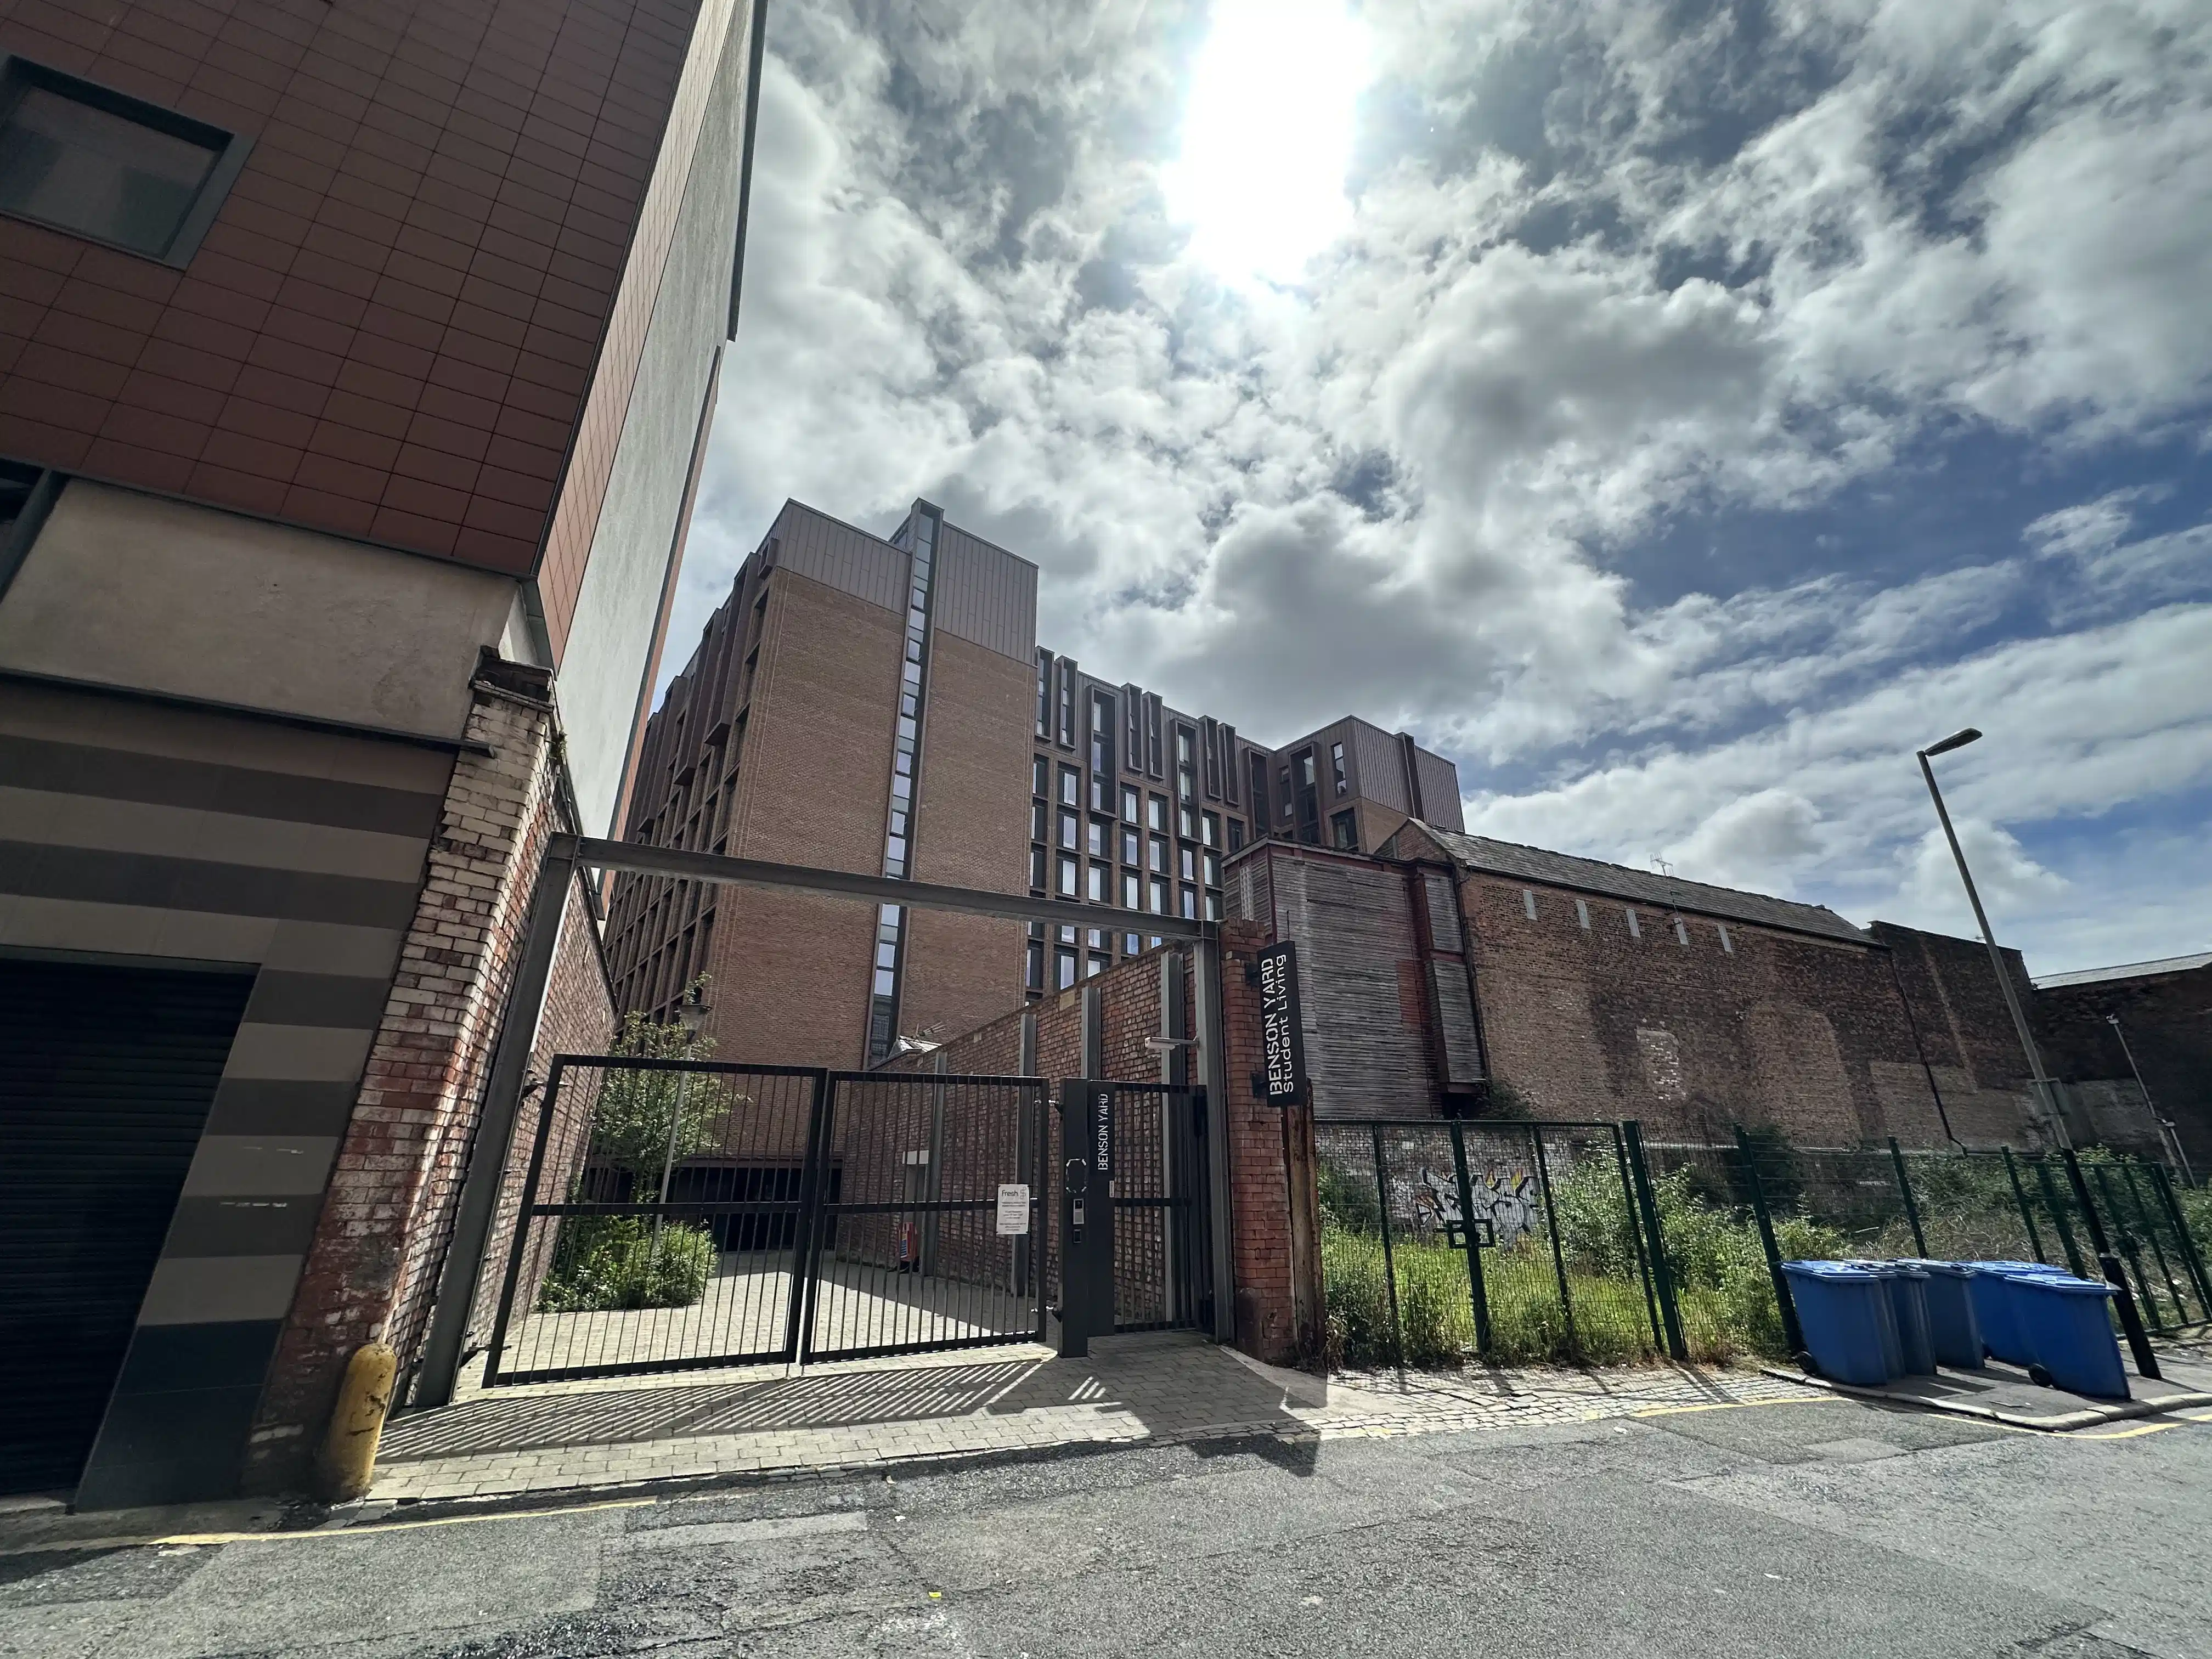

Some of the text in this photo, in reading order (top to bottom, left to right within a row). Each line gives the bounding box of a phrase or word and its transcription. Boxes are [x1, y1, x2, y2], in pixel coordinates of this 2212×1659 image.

[1261, 958, 1283, 1096] BENSON YARD
[1276, 953, 1294, 1093] Student Living
[1097, 1093, 1108, 1170] BENSON YARD
